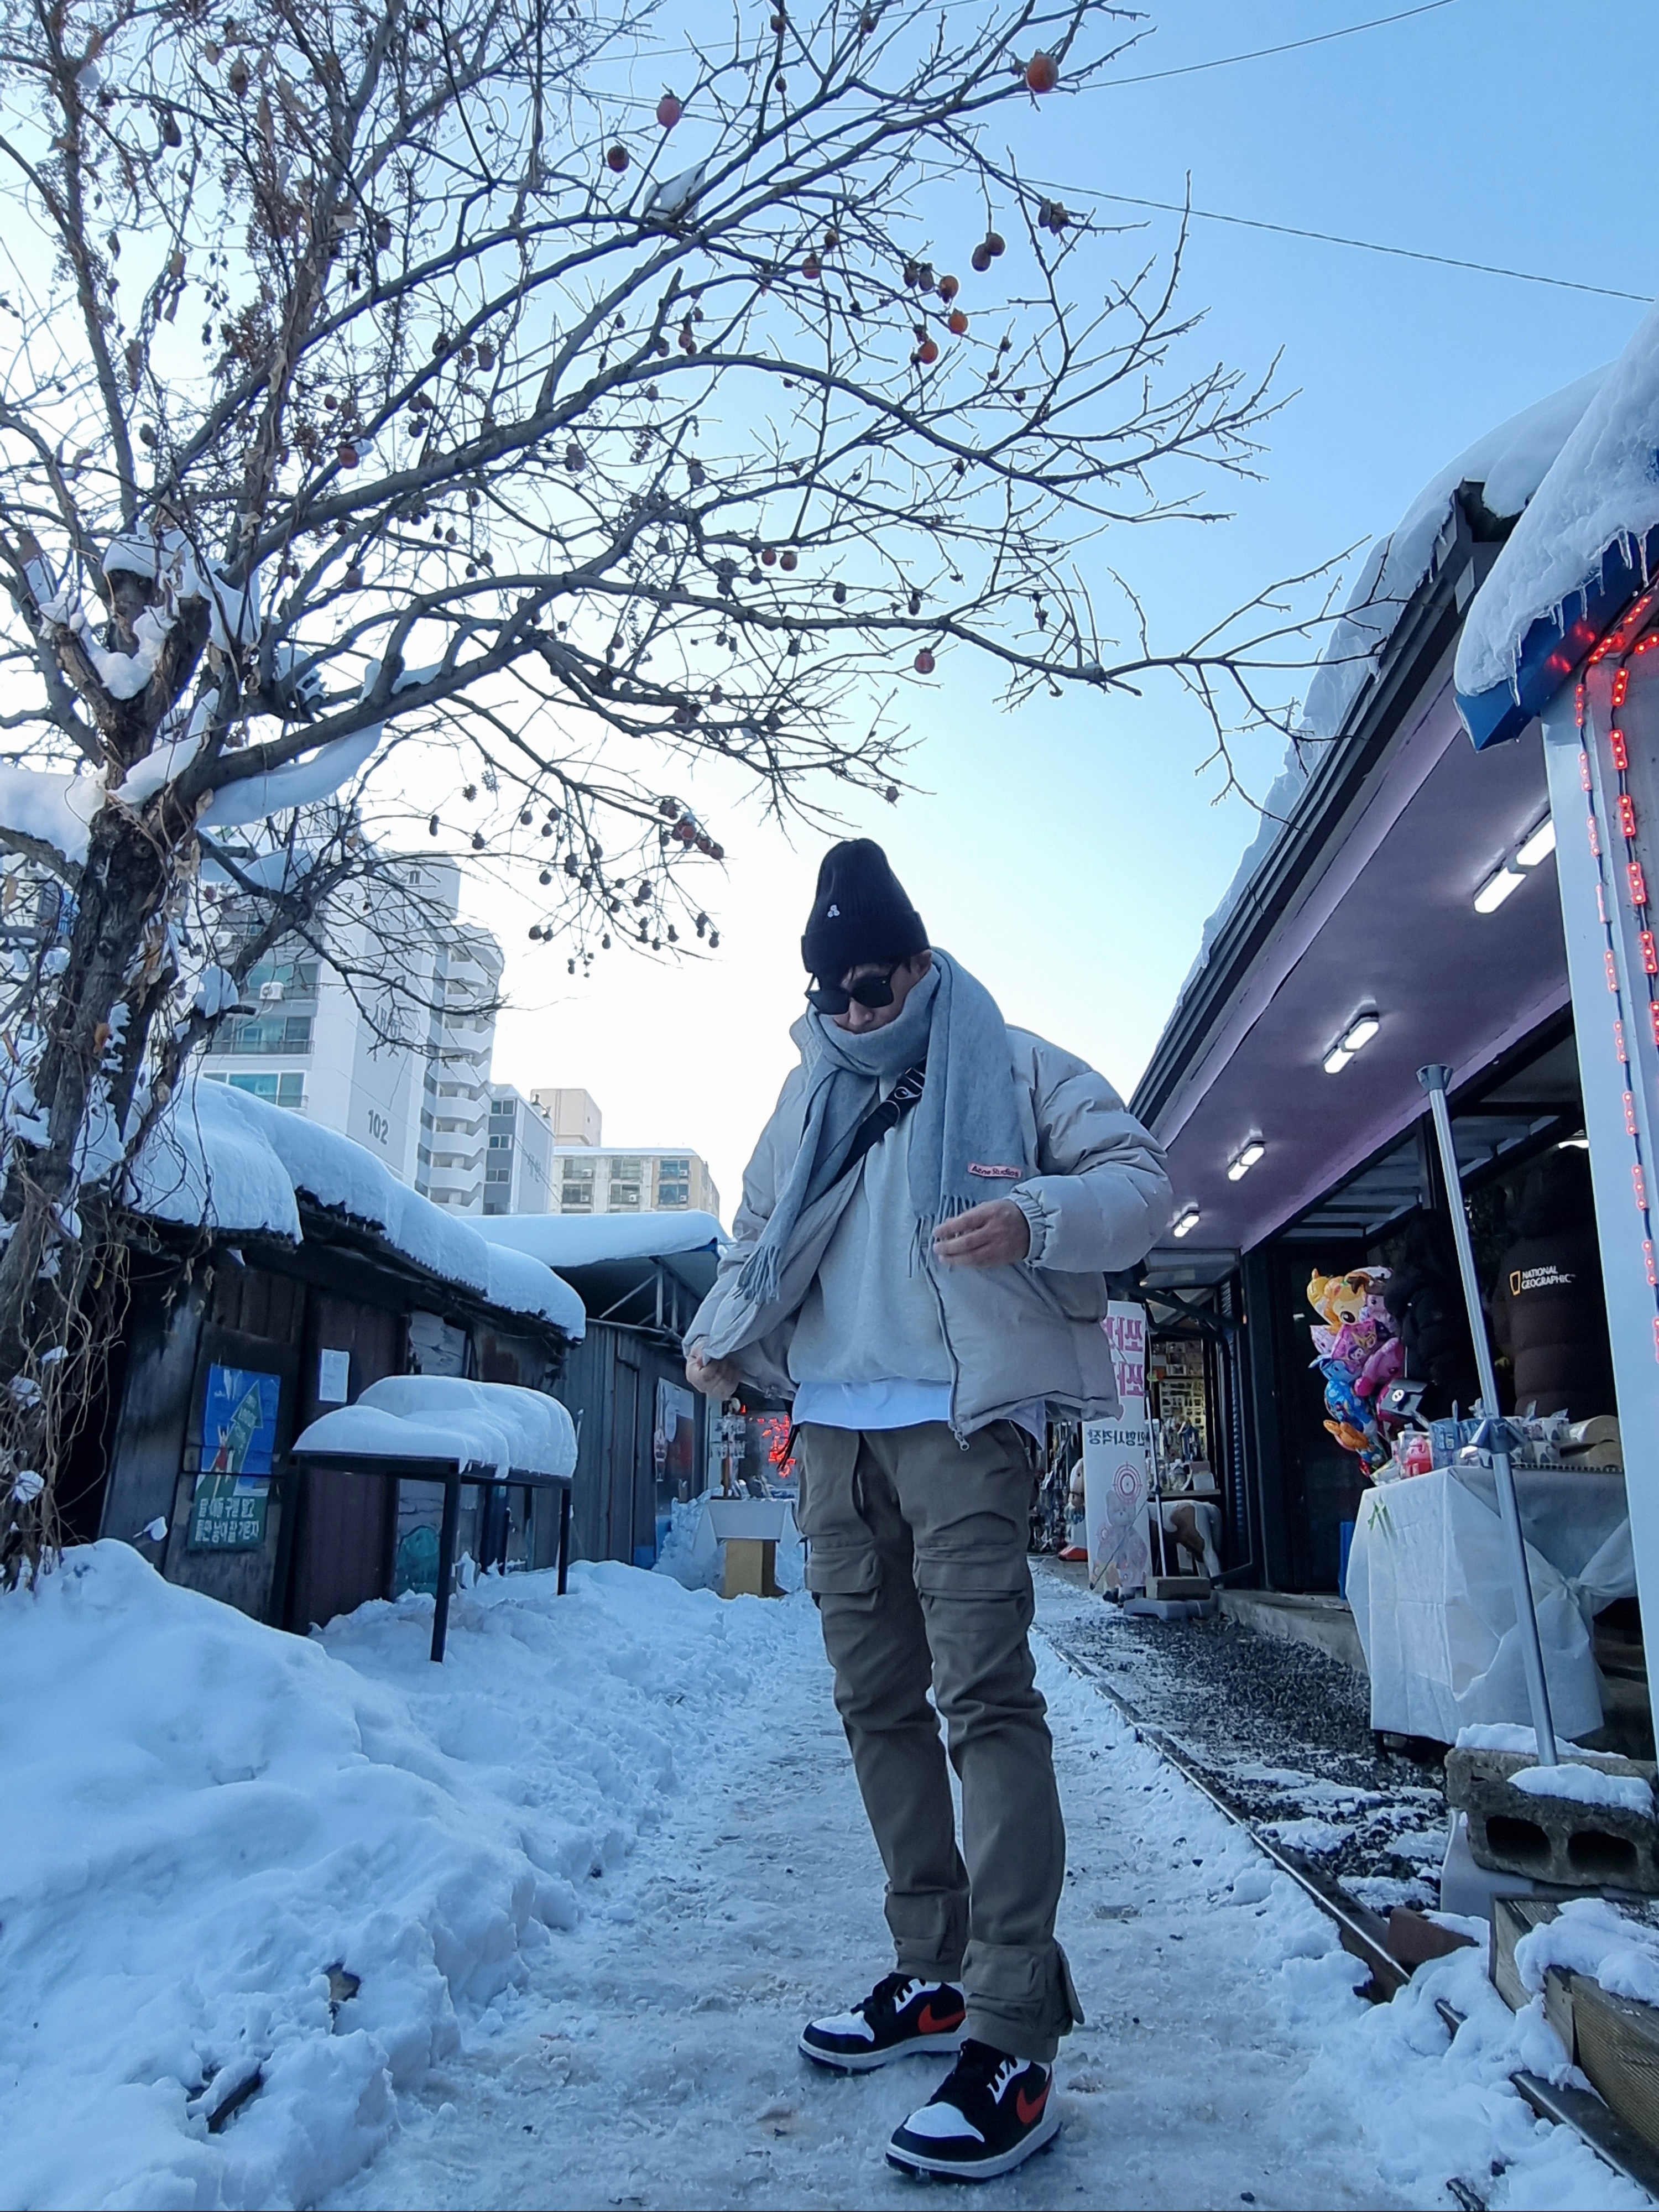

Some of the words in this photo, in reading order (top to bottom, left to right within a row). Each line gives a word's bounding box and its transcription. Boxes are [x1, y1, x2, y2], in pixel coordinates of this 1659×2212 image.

[368, 1109, 389, 1145] 102
[971, 1164, 991, 1175] Acne
[1522, 1265, 1558, 1280] NATIONAL
[1521, 1274, 1572, 1290] GEOGRAPHIC
